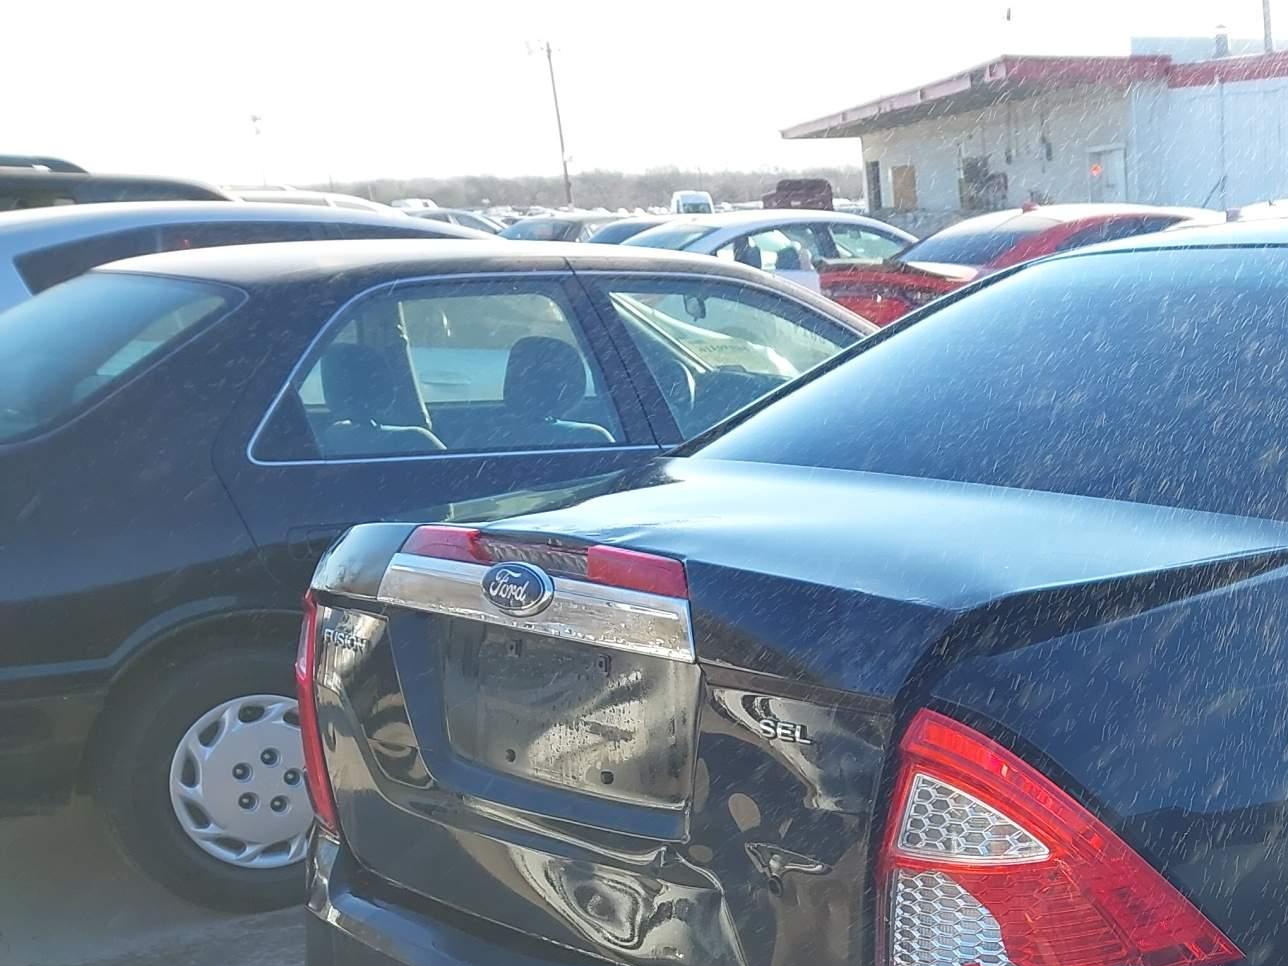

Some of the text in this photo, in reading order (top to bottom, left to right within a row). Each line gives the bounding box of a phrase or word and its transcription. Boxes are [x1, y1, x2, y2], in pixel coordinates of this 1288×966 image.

[489, 568, 530, 602] Ford
[323, 627, 366, 652] FUSION
[759, 719, 812, 745] SEL
